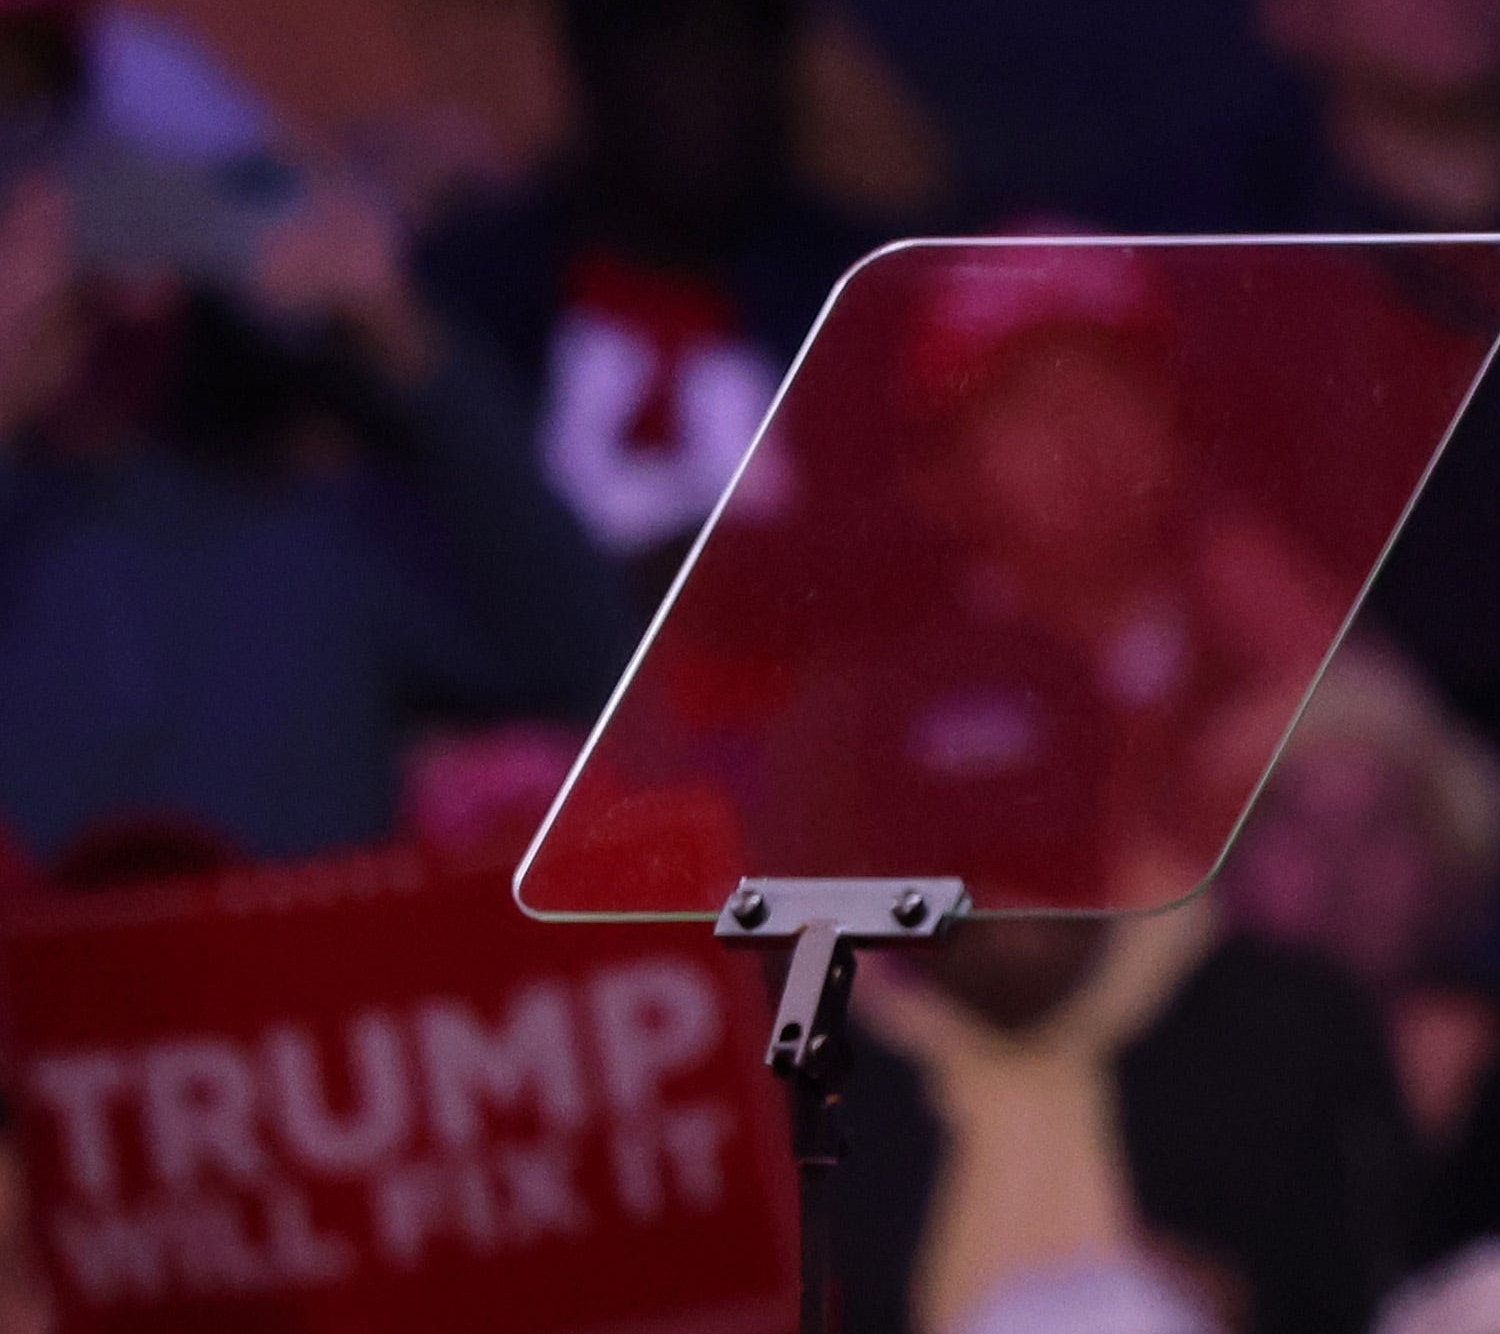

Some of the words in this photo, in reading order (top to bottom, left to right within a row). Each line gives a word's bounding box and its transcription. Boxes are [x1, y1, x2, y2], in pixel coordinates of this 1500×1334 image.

[29, 957, 727, 1194] TRUMP
[51, 1181, 359, 1306] WILL
[375, 1146, 593, 1267] FIX
[612, 1104, 737, 1226] IT
